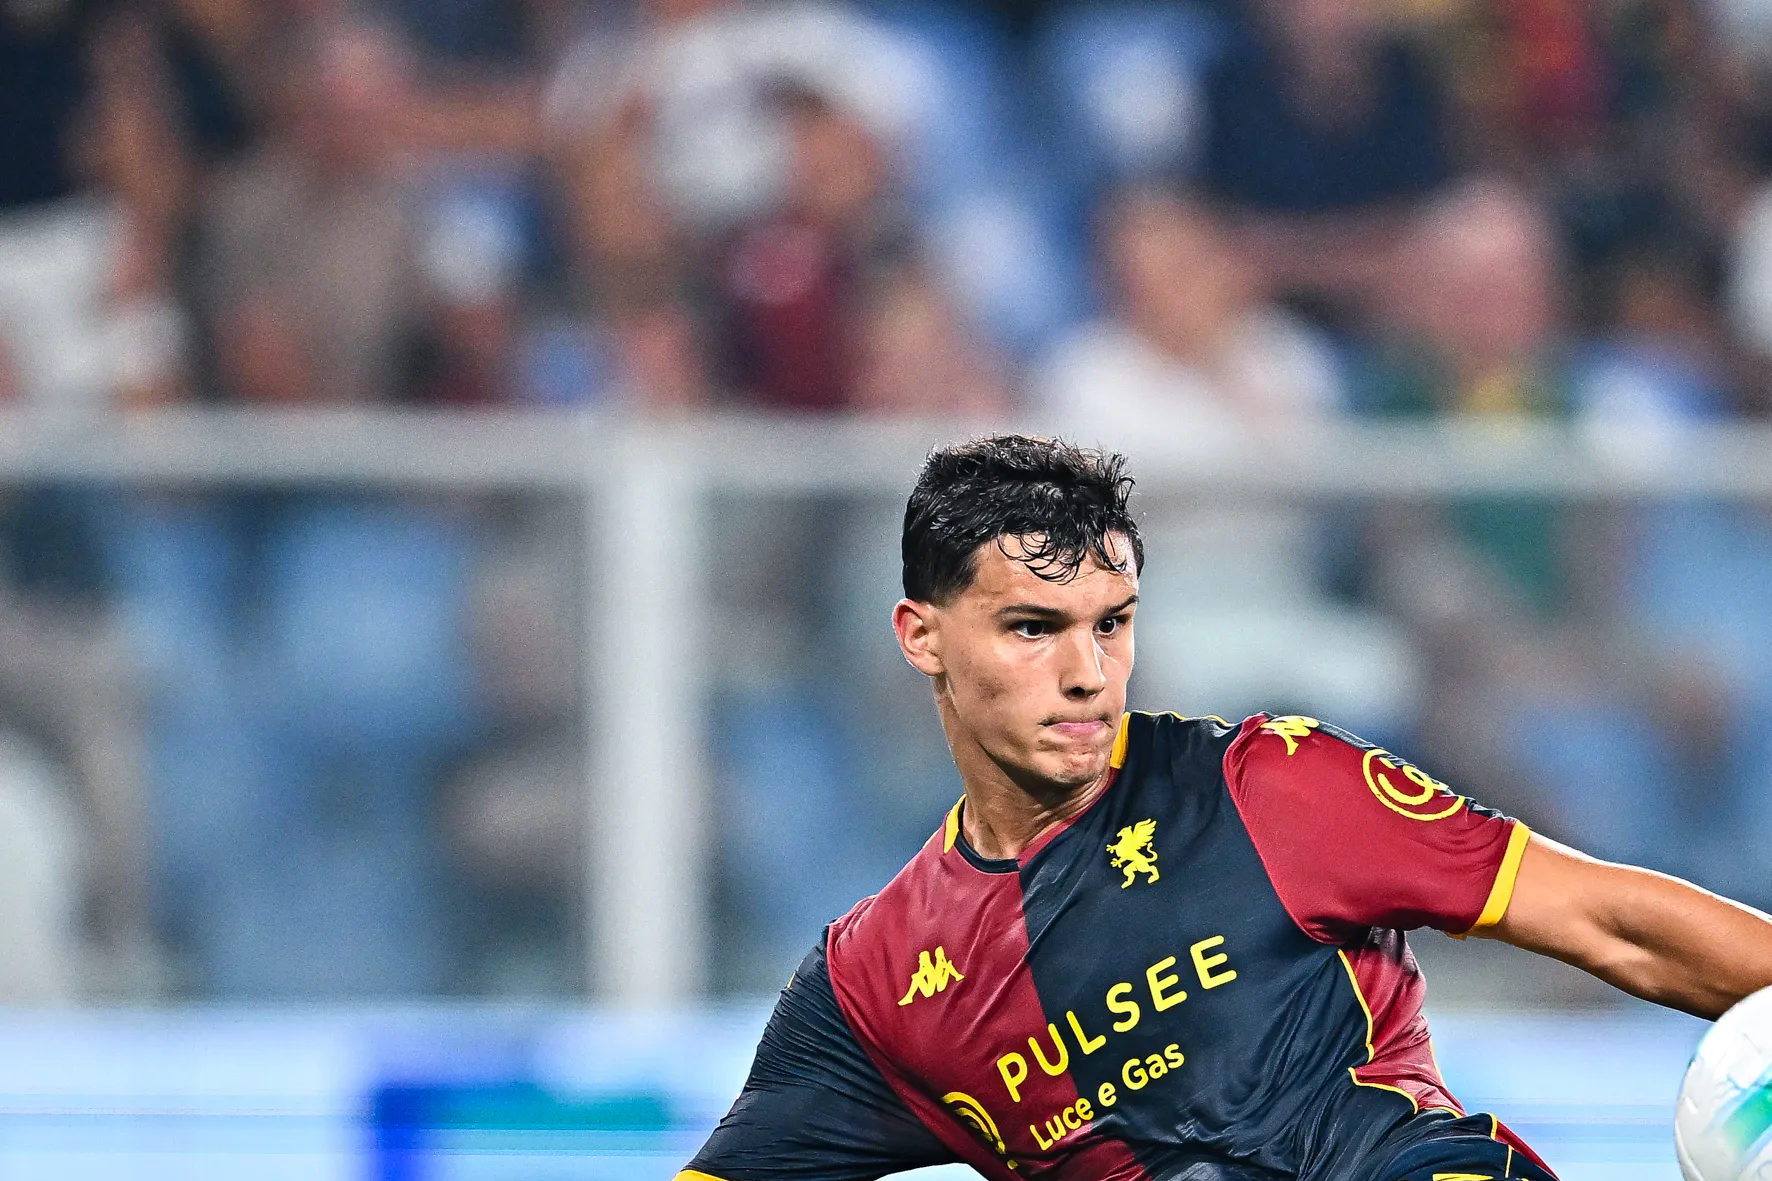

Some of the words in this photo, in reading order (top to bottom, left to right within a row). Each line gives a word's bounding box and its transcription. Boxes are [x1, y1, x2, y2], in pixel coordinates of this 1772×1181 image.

[997, 936, 1237, 1102] PULSEE
[1030, 1097, 1094, 1151] Luce
[1097, 1082, 1117, 1107] e
[1121, 1043, 1185, 1091] Gas
